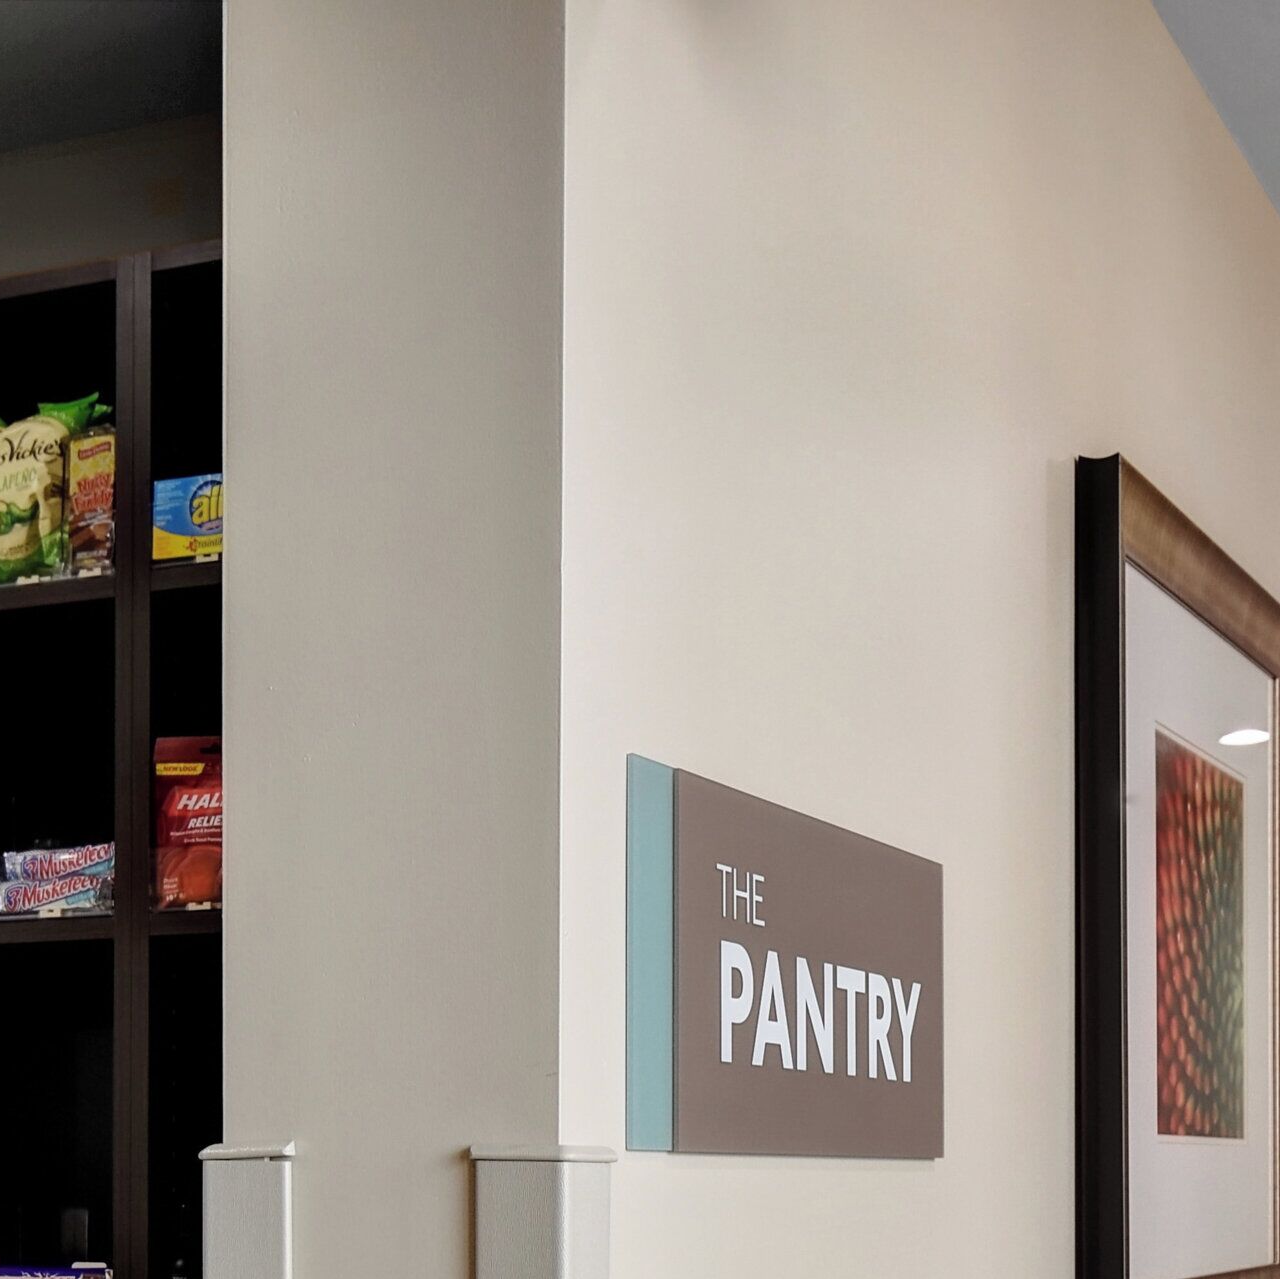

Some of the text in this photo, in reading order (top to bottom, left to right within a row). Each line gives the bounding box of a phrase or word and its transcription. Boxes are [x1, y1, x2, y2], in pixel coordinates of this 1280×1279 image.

[177, 792, 223, 811] HAL
[188, 815, 222, 829] RELIE
[716, 863, 766, 927] THE
[720, 940, 921, 1083] PANTRY
